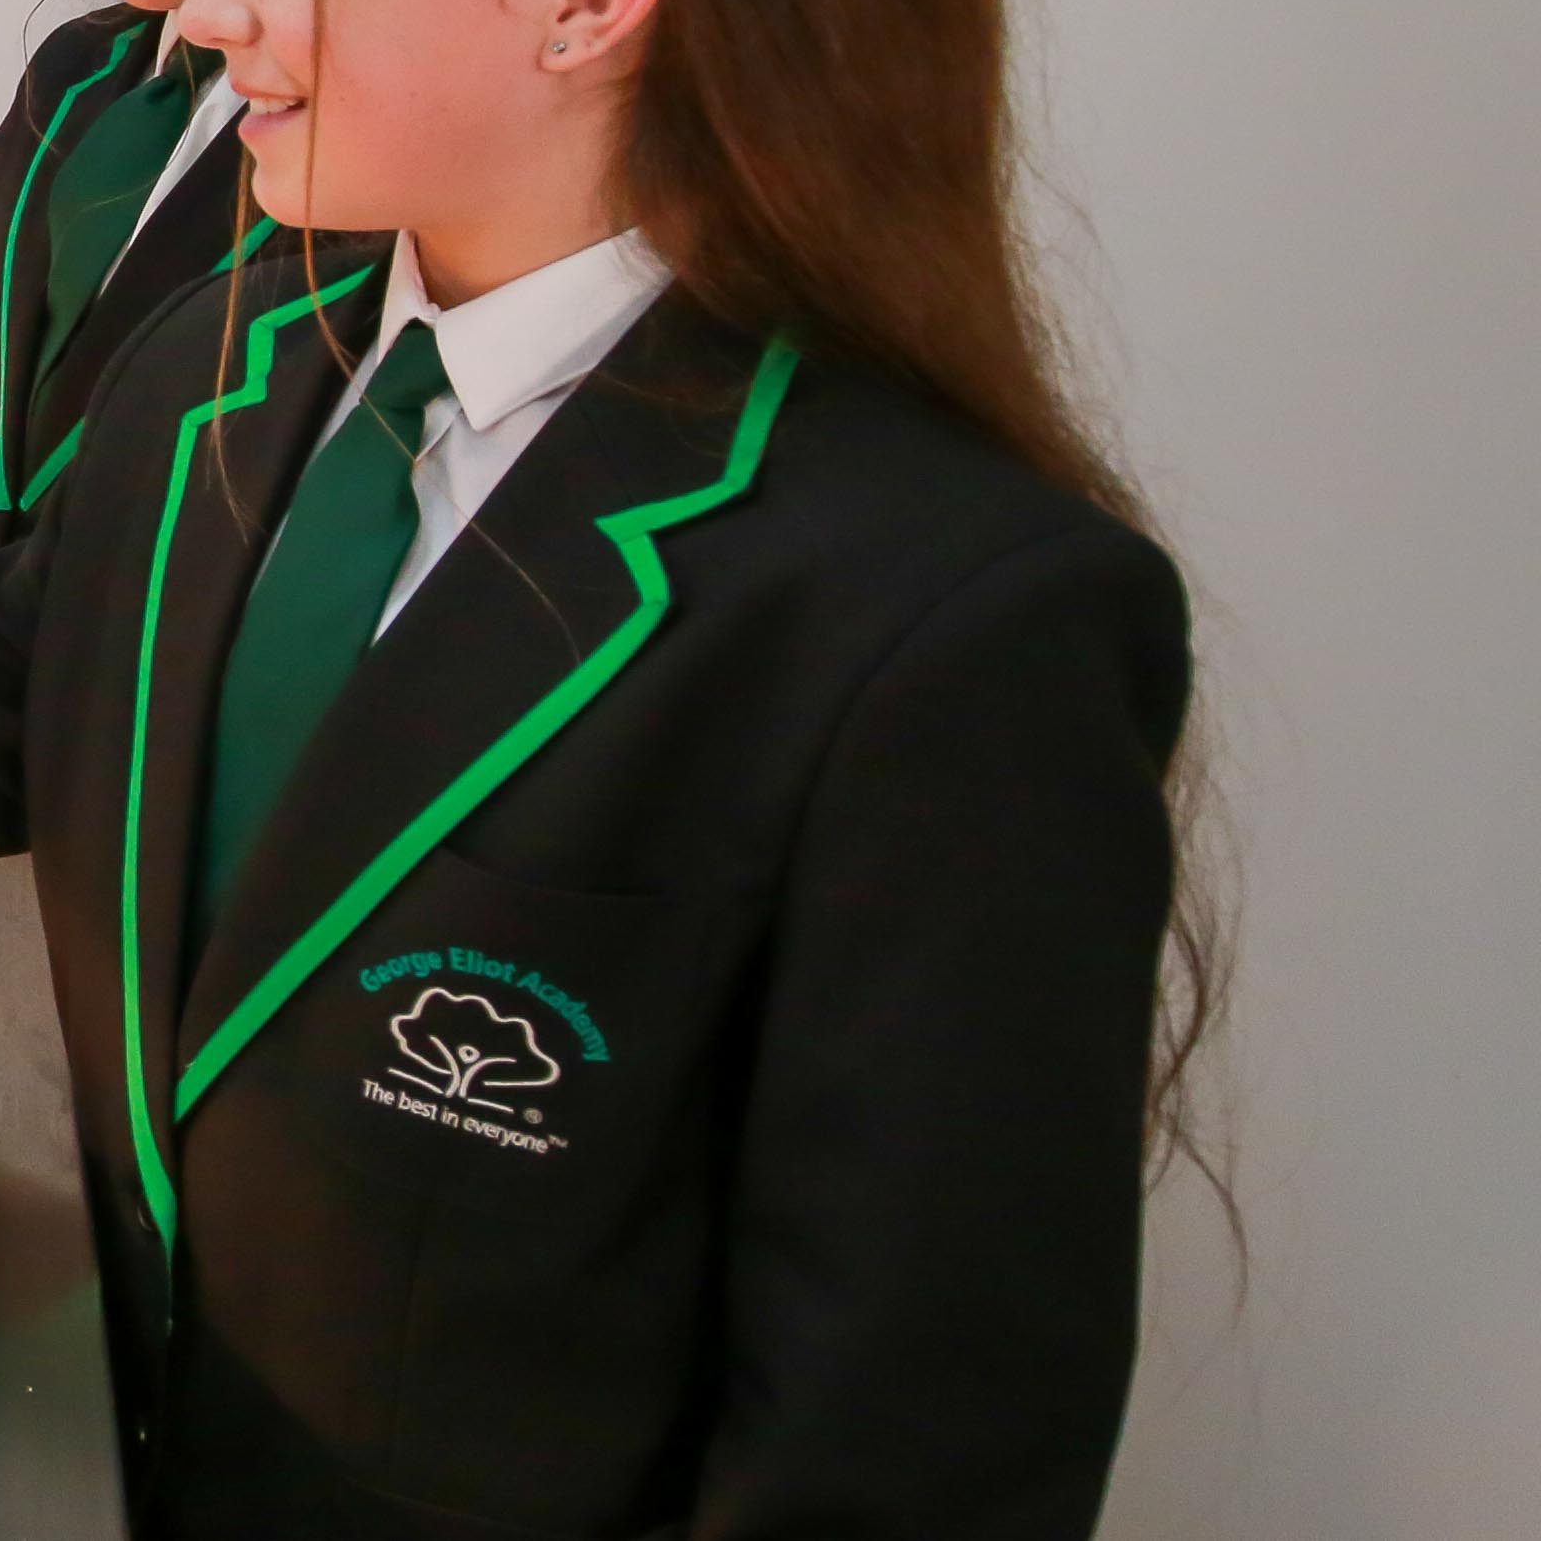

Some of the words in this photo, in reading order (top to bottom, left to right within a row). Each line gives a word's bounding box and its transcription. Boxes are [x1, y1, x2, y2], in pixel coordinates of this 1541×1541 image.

[360, 952, 443, 992] George
[449, 946, 517, 984] Eliot
[517, 971, 611, 1062] Academy
[363, 1078, 395, 1106] The
[398, 1090, 438, 1122] best
[439, 1106, 460, 1129] in
